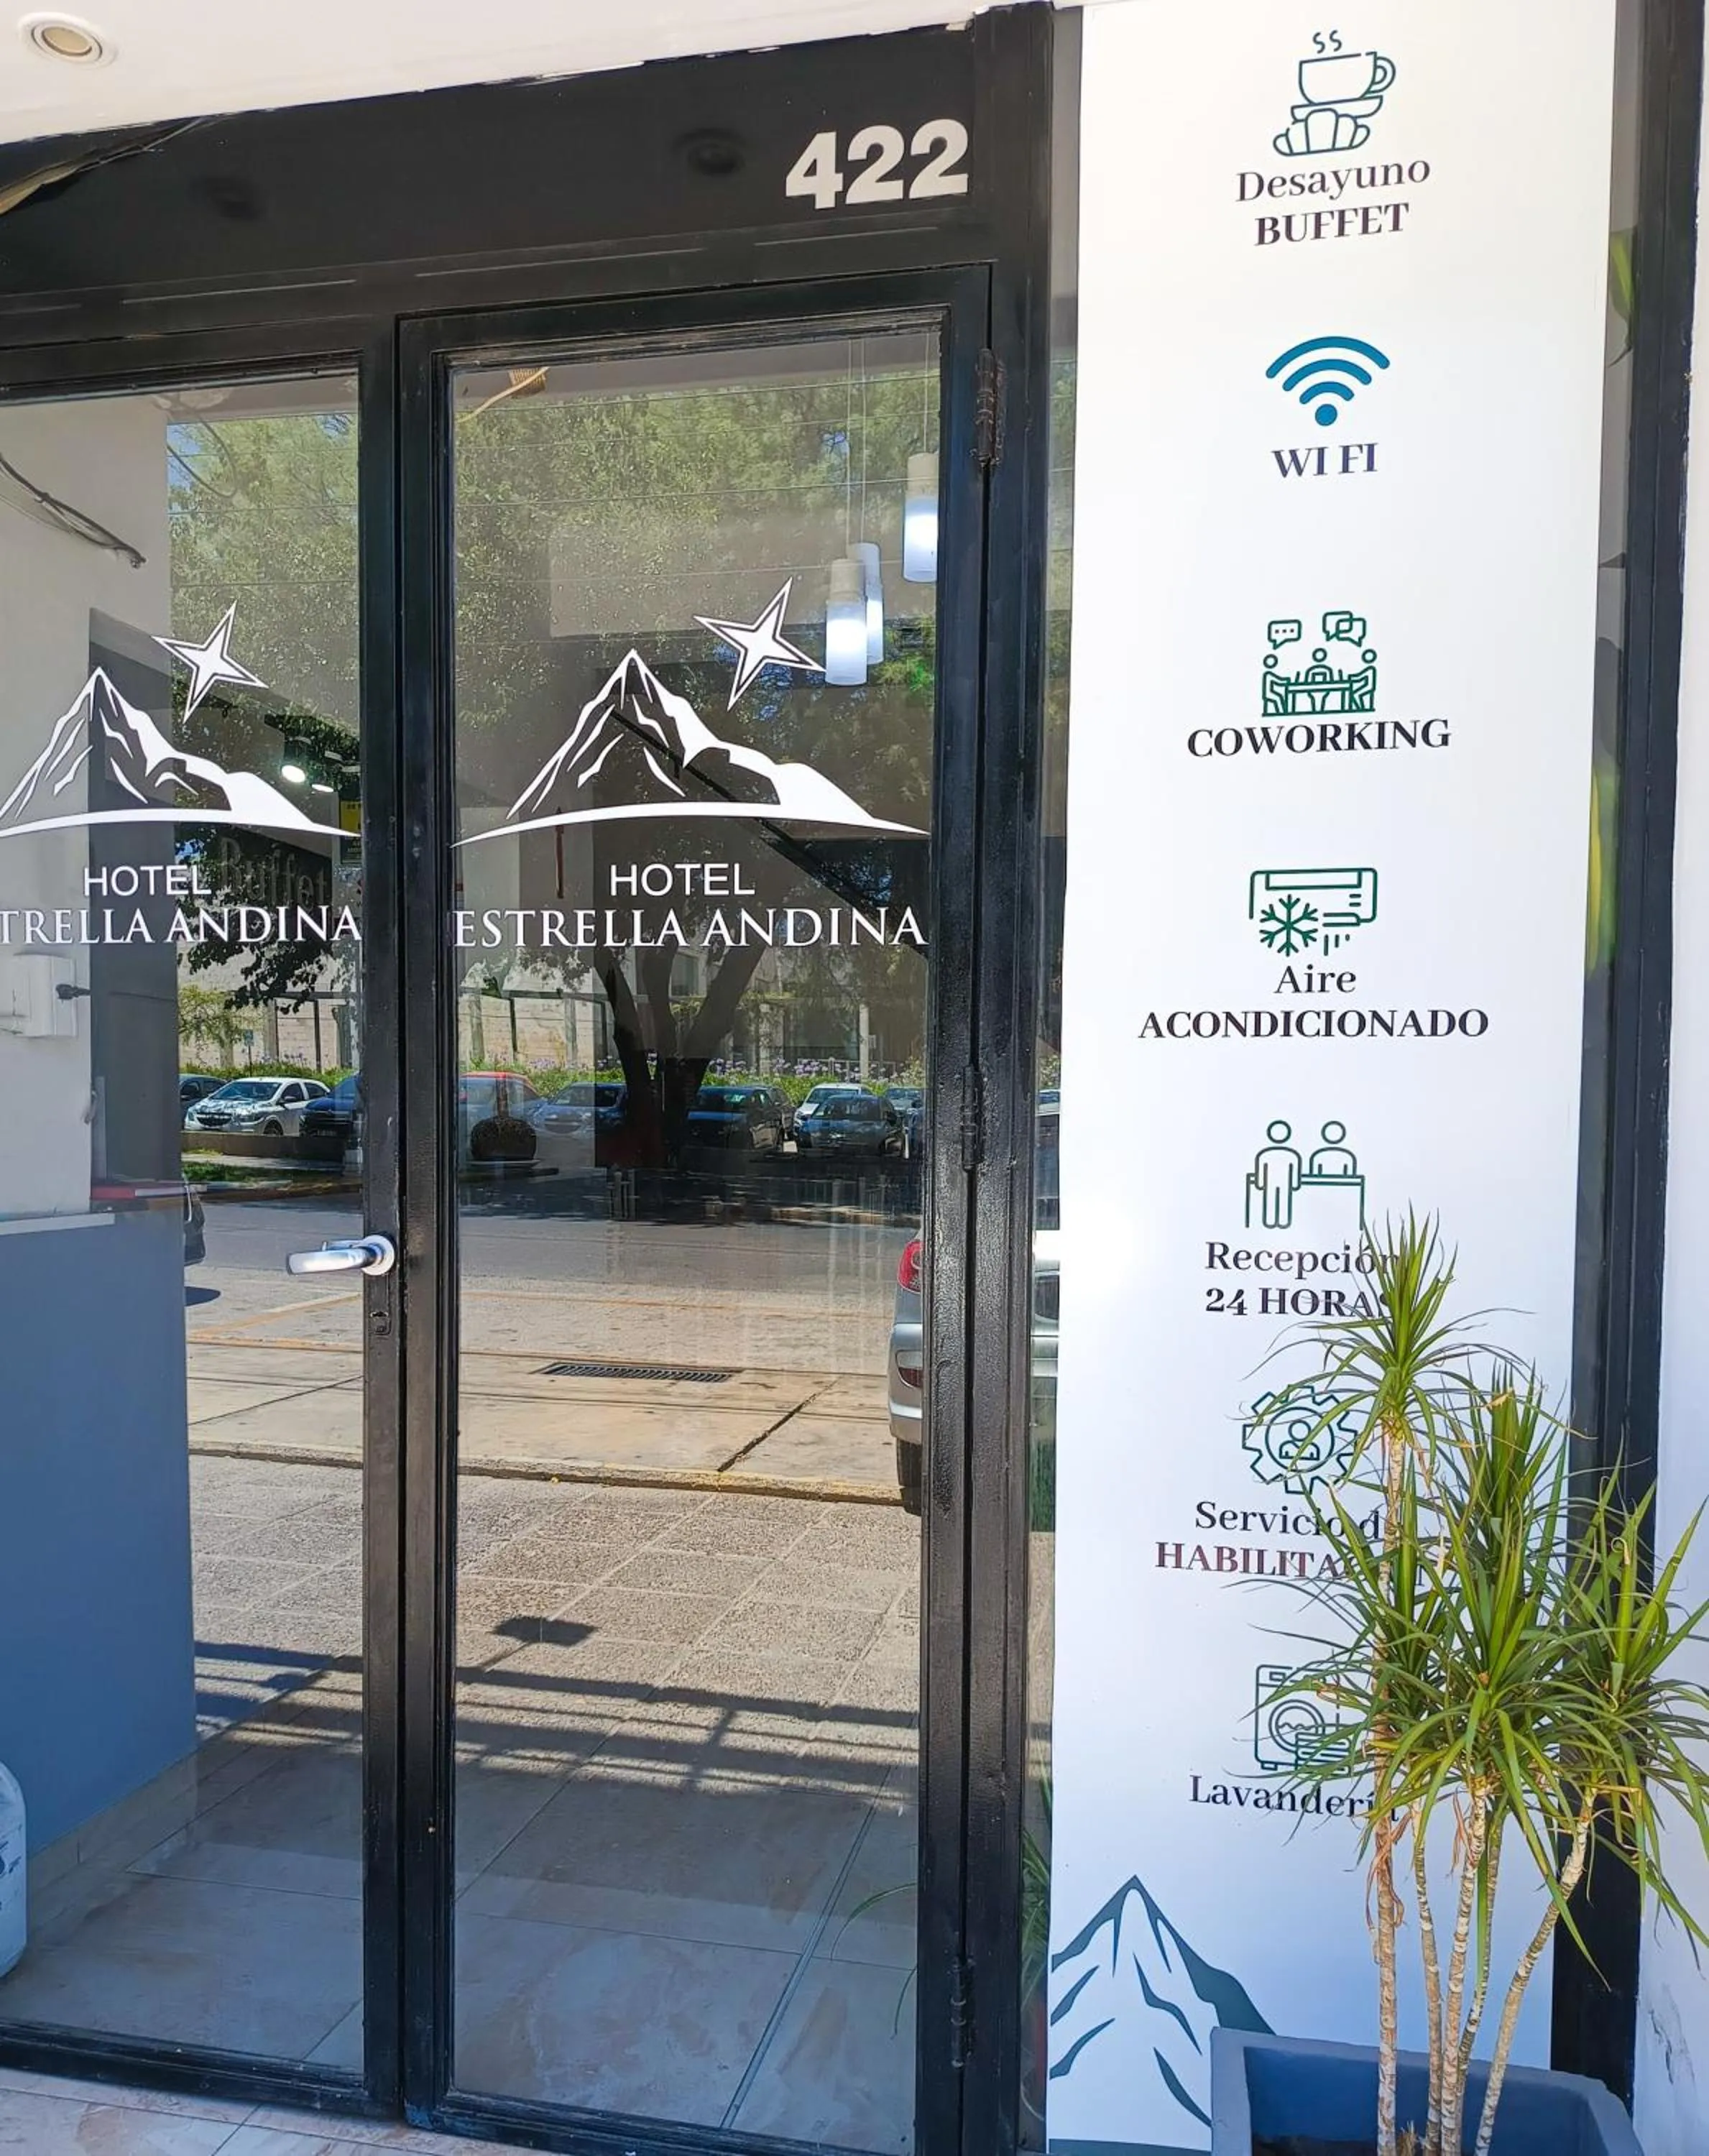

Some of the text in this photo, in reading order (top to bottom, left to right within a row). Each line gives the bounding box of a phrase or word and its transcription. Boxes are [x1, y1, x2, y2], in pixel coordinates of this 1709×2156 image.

[786, 119, 969, 209] 422
[1235, 160, 1430, 202] Desayuno
[1254, 202, 1409, 246] BUFFET
[1271, 443, 1378, 478] WI FI
[1187, 719, 1452, 757] COWORKING
[84, 865, 212, 897] HOTEL
[218, 835, 329, 913] Buffet
[611, 863, 755, 897] HOTEL
[0, 905, 362, 944] TRELLA ANDINA
[453, 906, 929, 948] ESTRELLA ANDINA
[1273, 964, 1357, 994] Aire
[1138, 1008, 1489, 1038] ACONDICIONADO
[1204, 1241, 1401, 1281] Recepción
[1205, 1287, 1248, 1316] 24
[1195, 1501, 1345, 1537] Servicio
[1155, 1541, 1426, 1587] HABILITA
